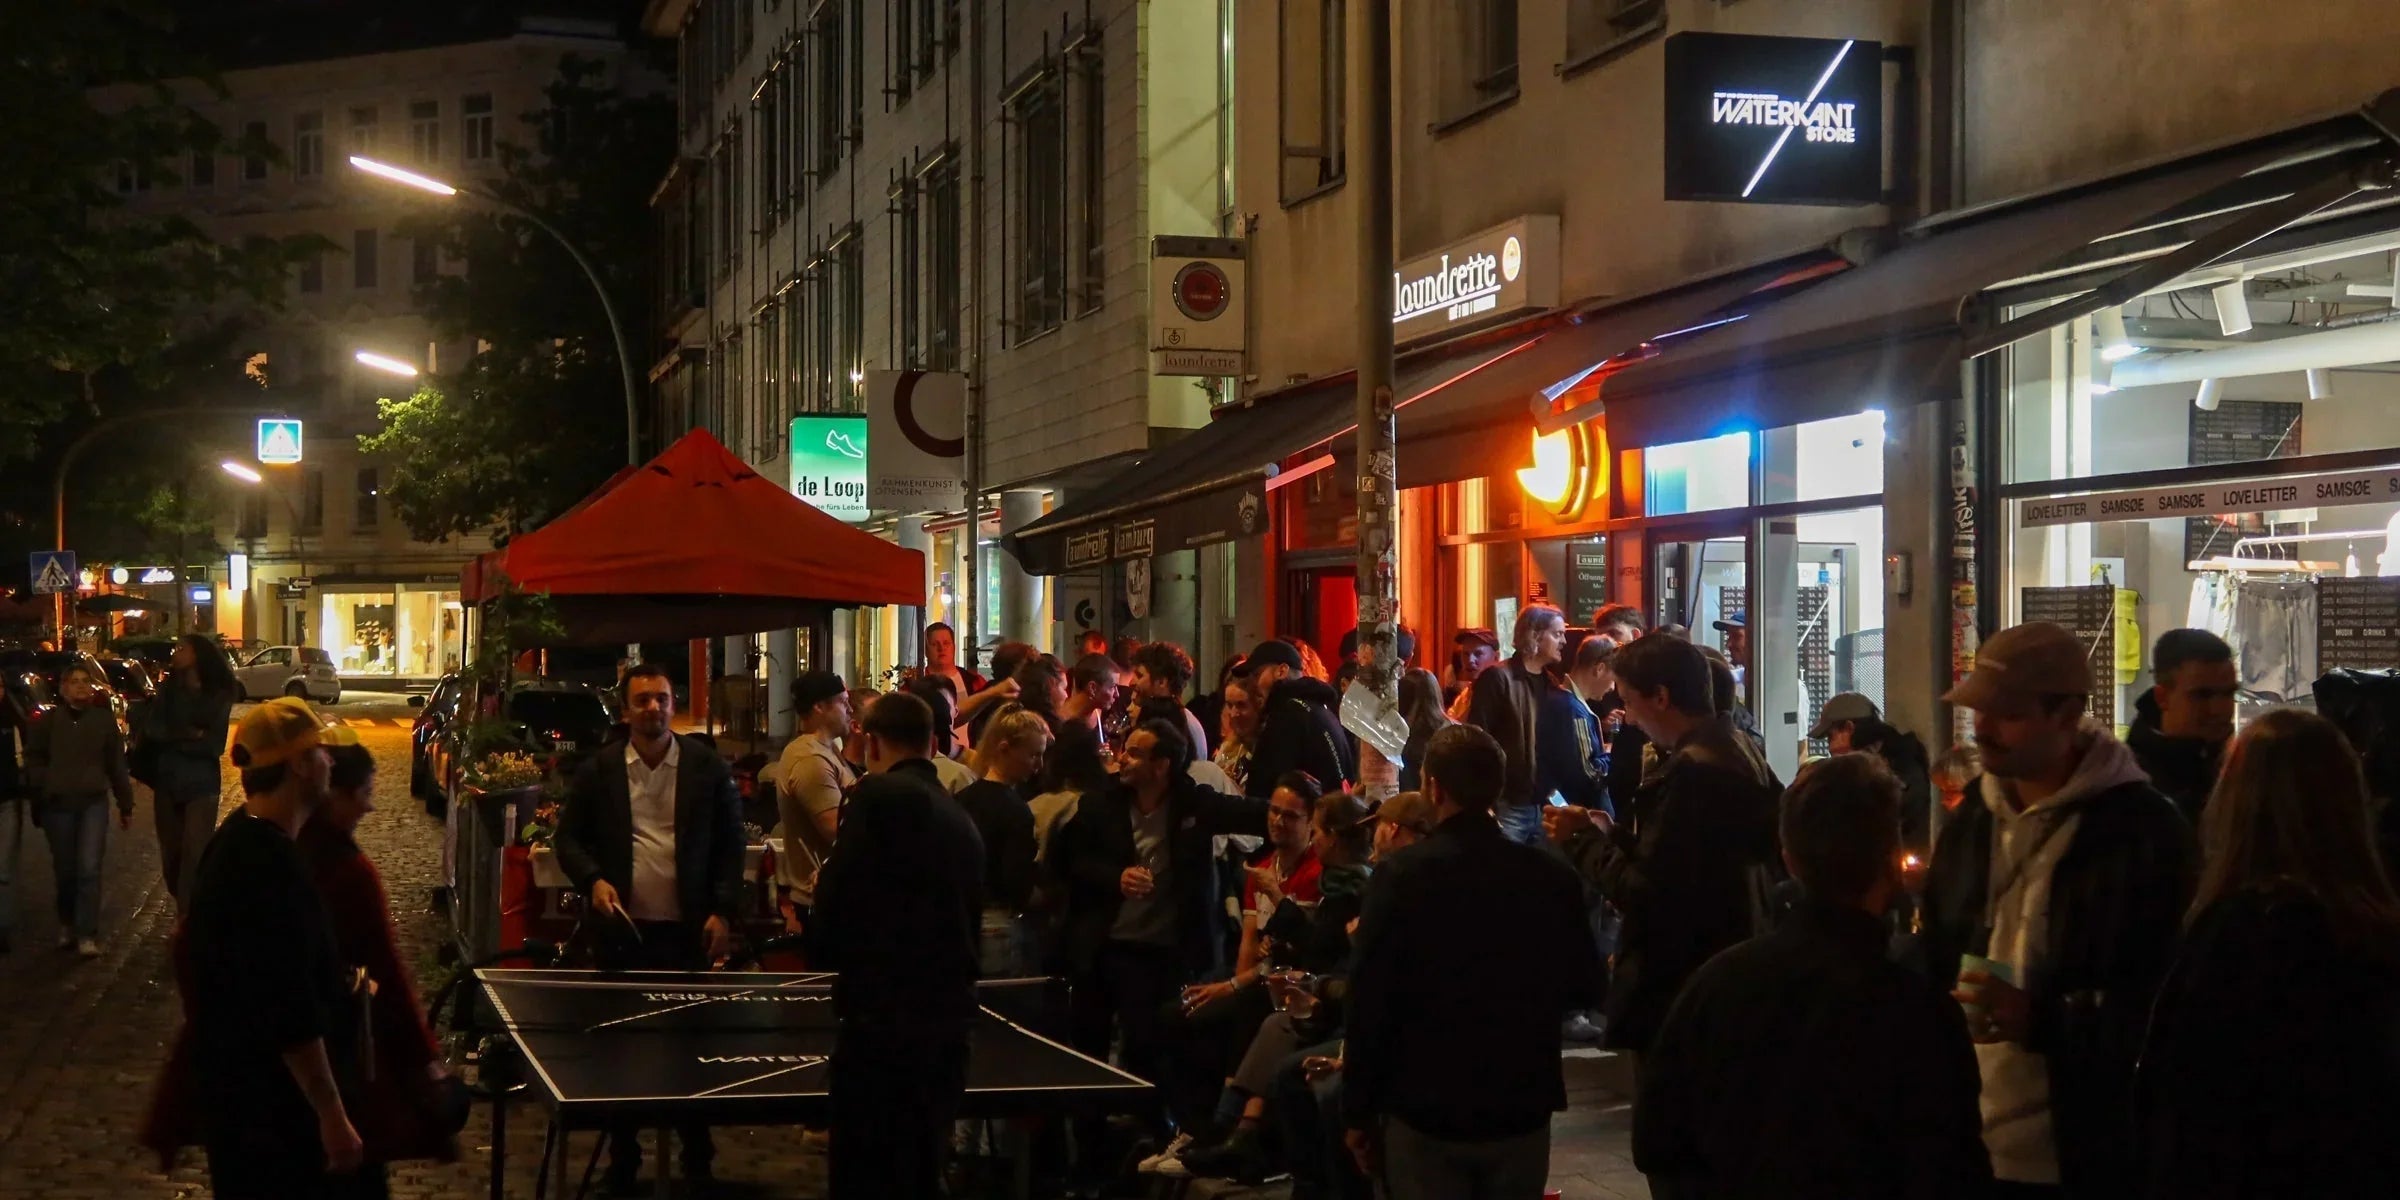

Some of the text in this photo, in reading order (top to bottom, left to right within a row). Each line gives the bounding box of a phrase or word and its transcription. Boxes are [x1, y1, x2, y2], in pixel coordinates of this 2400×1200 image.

[1713, 98, 1855, 128] WATERKANT
[1806, 126, 1855, 142] STORE
[1394, 252, 1497, 316] laundrette
[798, 475, 864, 502] de Loop
[874, 487, 922, 496] OTTENSEN
[881, 479, 953, 489] RAHMENKUNST
[826, 503, 841, 511] fürs
[843, 503, 865, 511] Leben
[2028, 506, 2050, 521] LOVE
[2051, 503, 2087, 519] LETTER
[2101, 498, 2145, 515] SAMSØE
[2158, 493, 2205, 511] SAMSØE
[2223, 489, 2252, 507] LOVE
[2253, 486, 2297, 503] LETTER
[2316, 480, 2371, 499] SAMSØE
[1576, 554, 1606, 566] Laund
